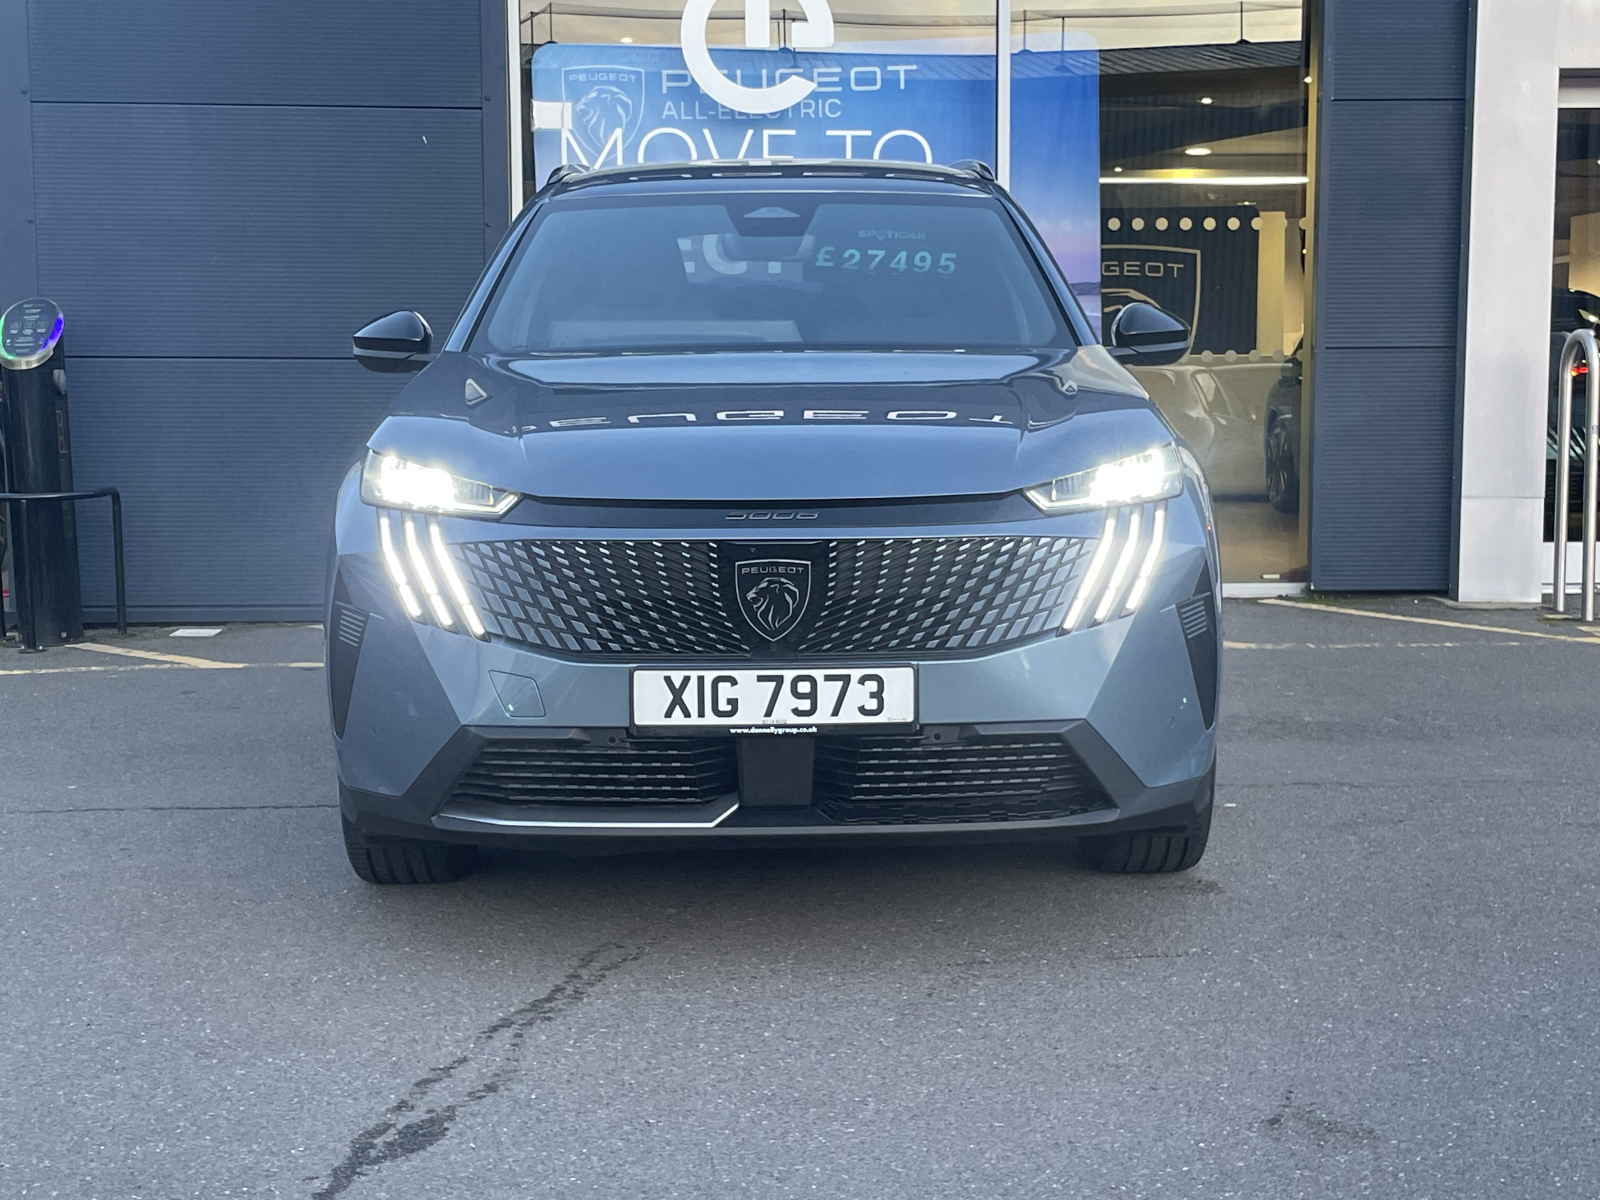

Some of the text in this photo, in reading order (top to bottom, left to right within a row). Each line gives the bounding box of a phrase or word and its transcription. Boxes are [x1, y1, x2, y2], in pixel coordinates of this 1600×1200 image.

[569, 73, 637, 82] PEUGEOT
[826, 129, 933, 164] TO
[741, 566, 805, 575] PEUGEOT
[663, 673, 885, 719] XIG 7973
